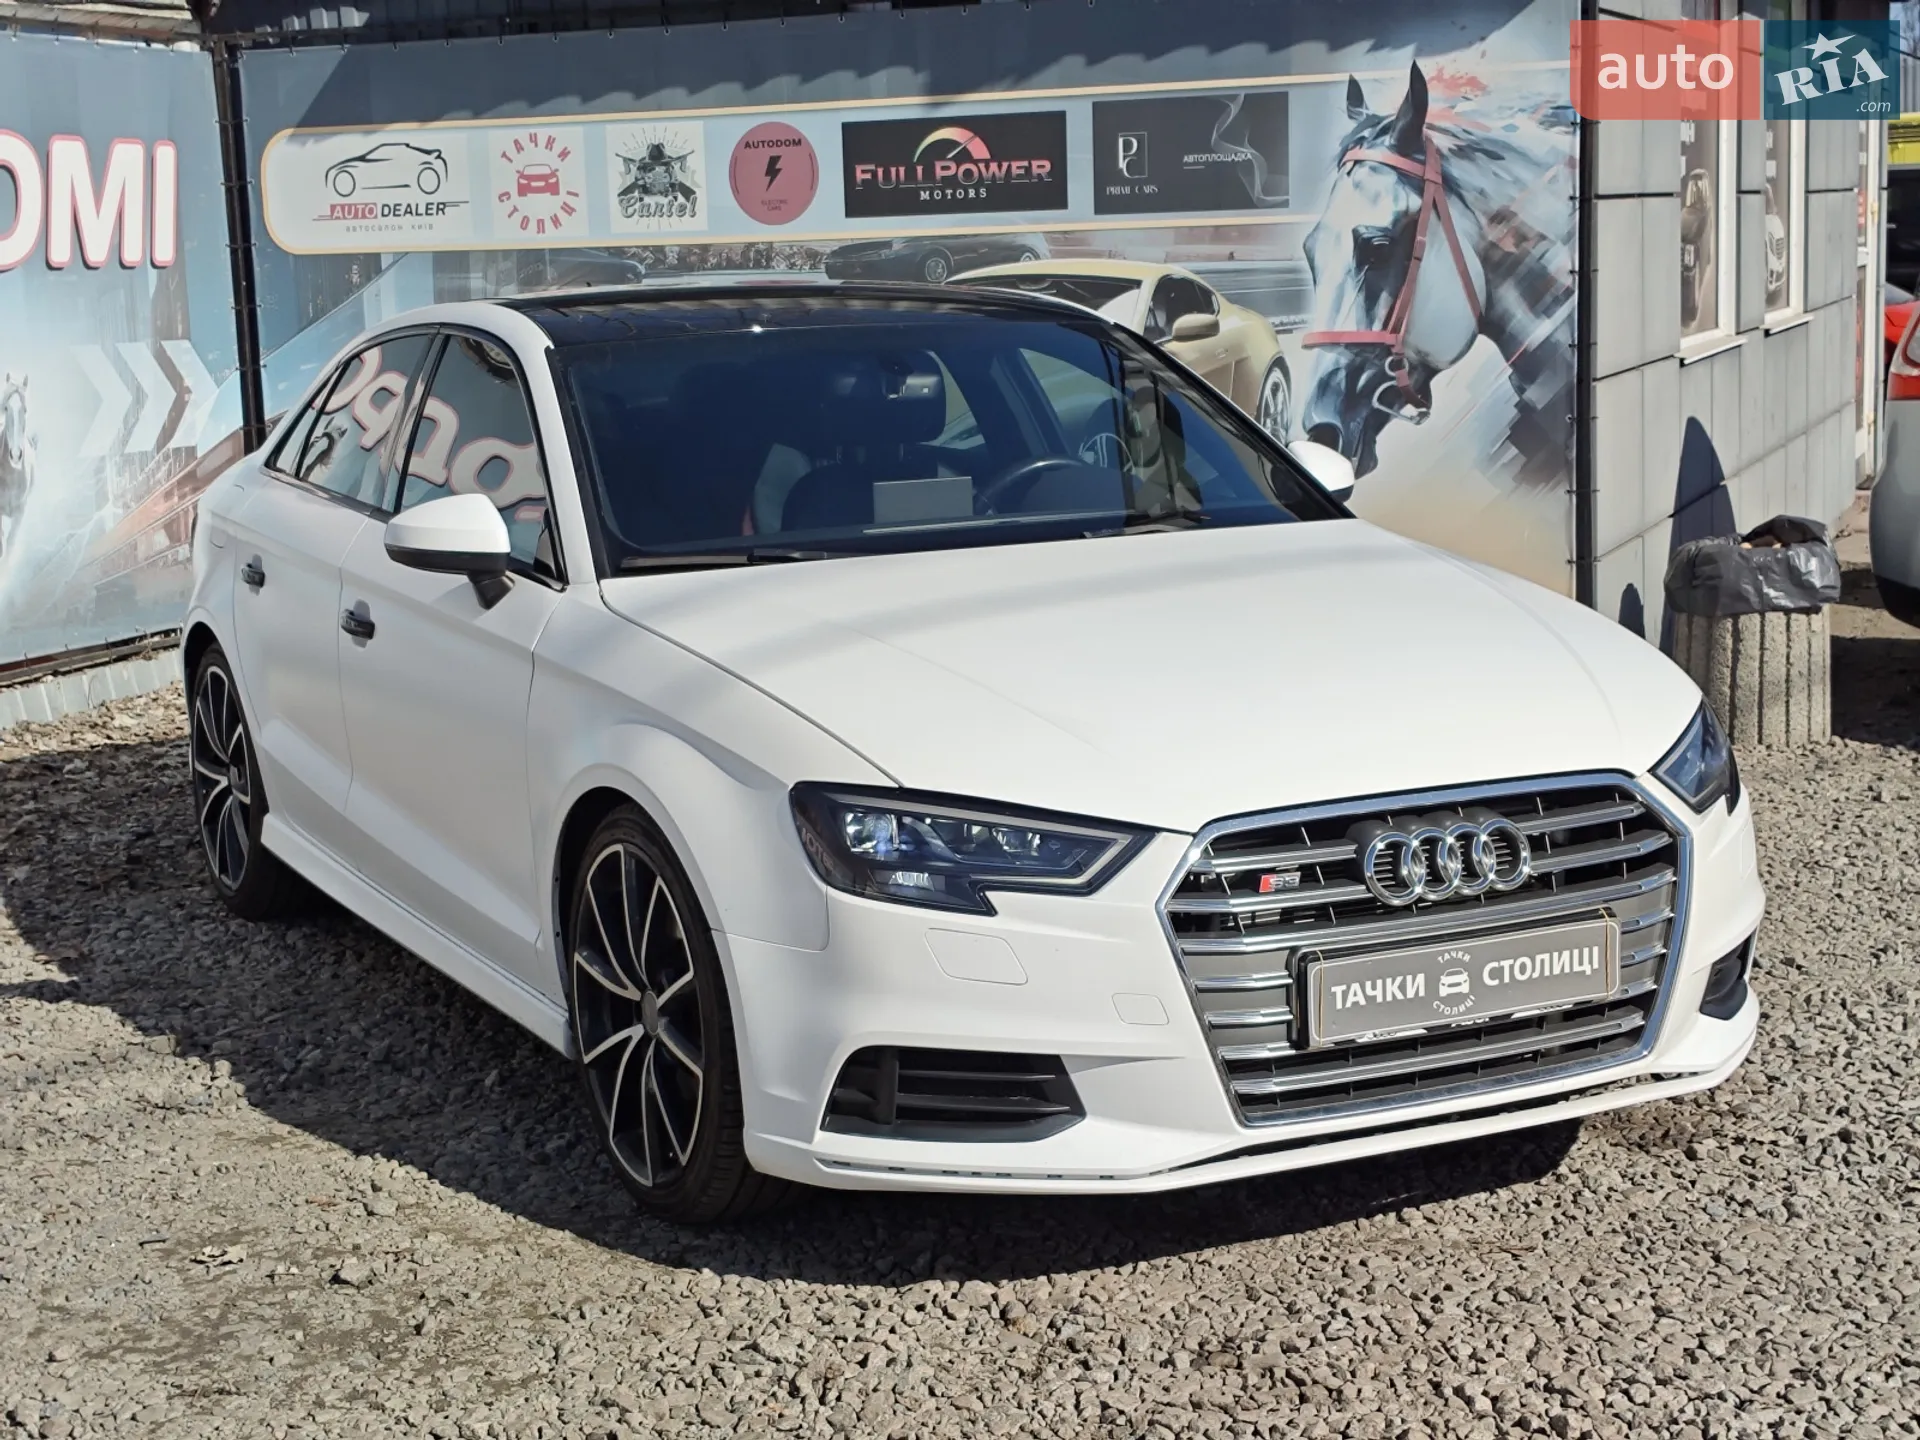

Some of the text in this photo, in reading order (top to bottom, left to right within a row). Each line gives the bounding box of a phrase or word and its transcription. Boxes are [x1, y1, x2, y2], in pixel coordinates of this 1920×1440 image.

[501, 132, 571, 164] ТАЧКИ
[743, 137, 803, 150] AUTODOM
[1183, 152, 1253, 163] АВТОПЛОЩАДКА
[920, 188, 988, 201] MOTORS
[332, 202, 447, 219] AUTO DEALER
[498, 190, 580, 234] СТОЛИЦІ
[1437, 950, 1471, 964] ТАЧКИ
[1331, 946, 1600, 1010] ТАЧКИ СТОЛИЦІ
[1432, 994, 1476, 1015] СТОЛИЦІ
